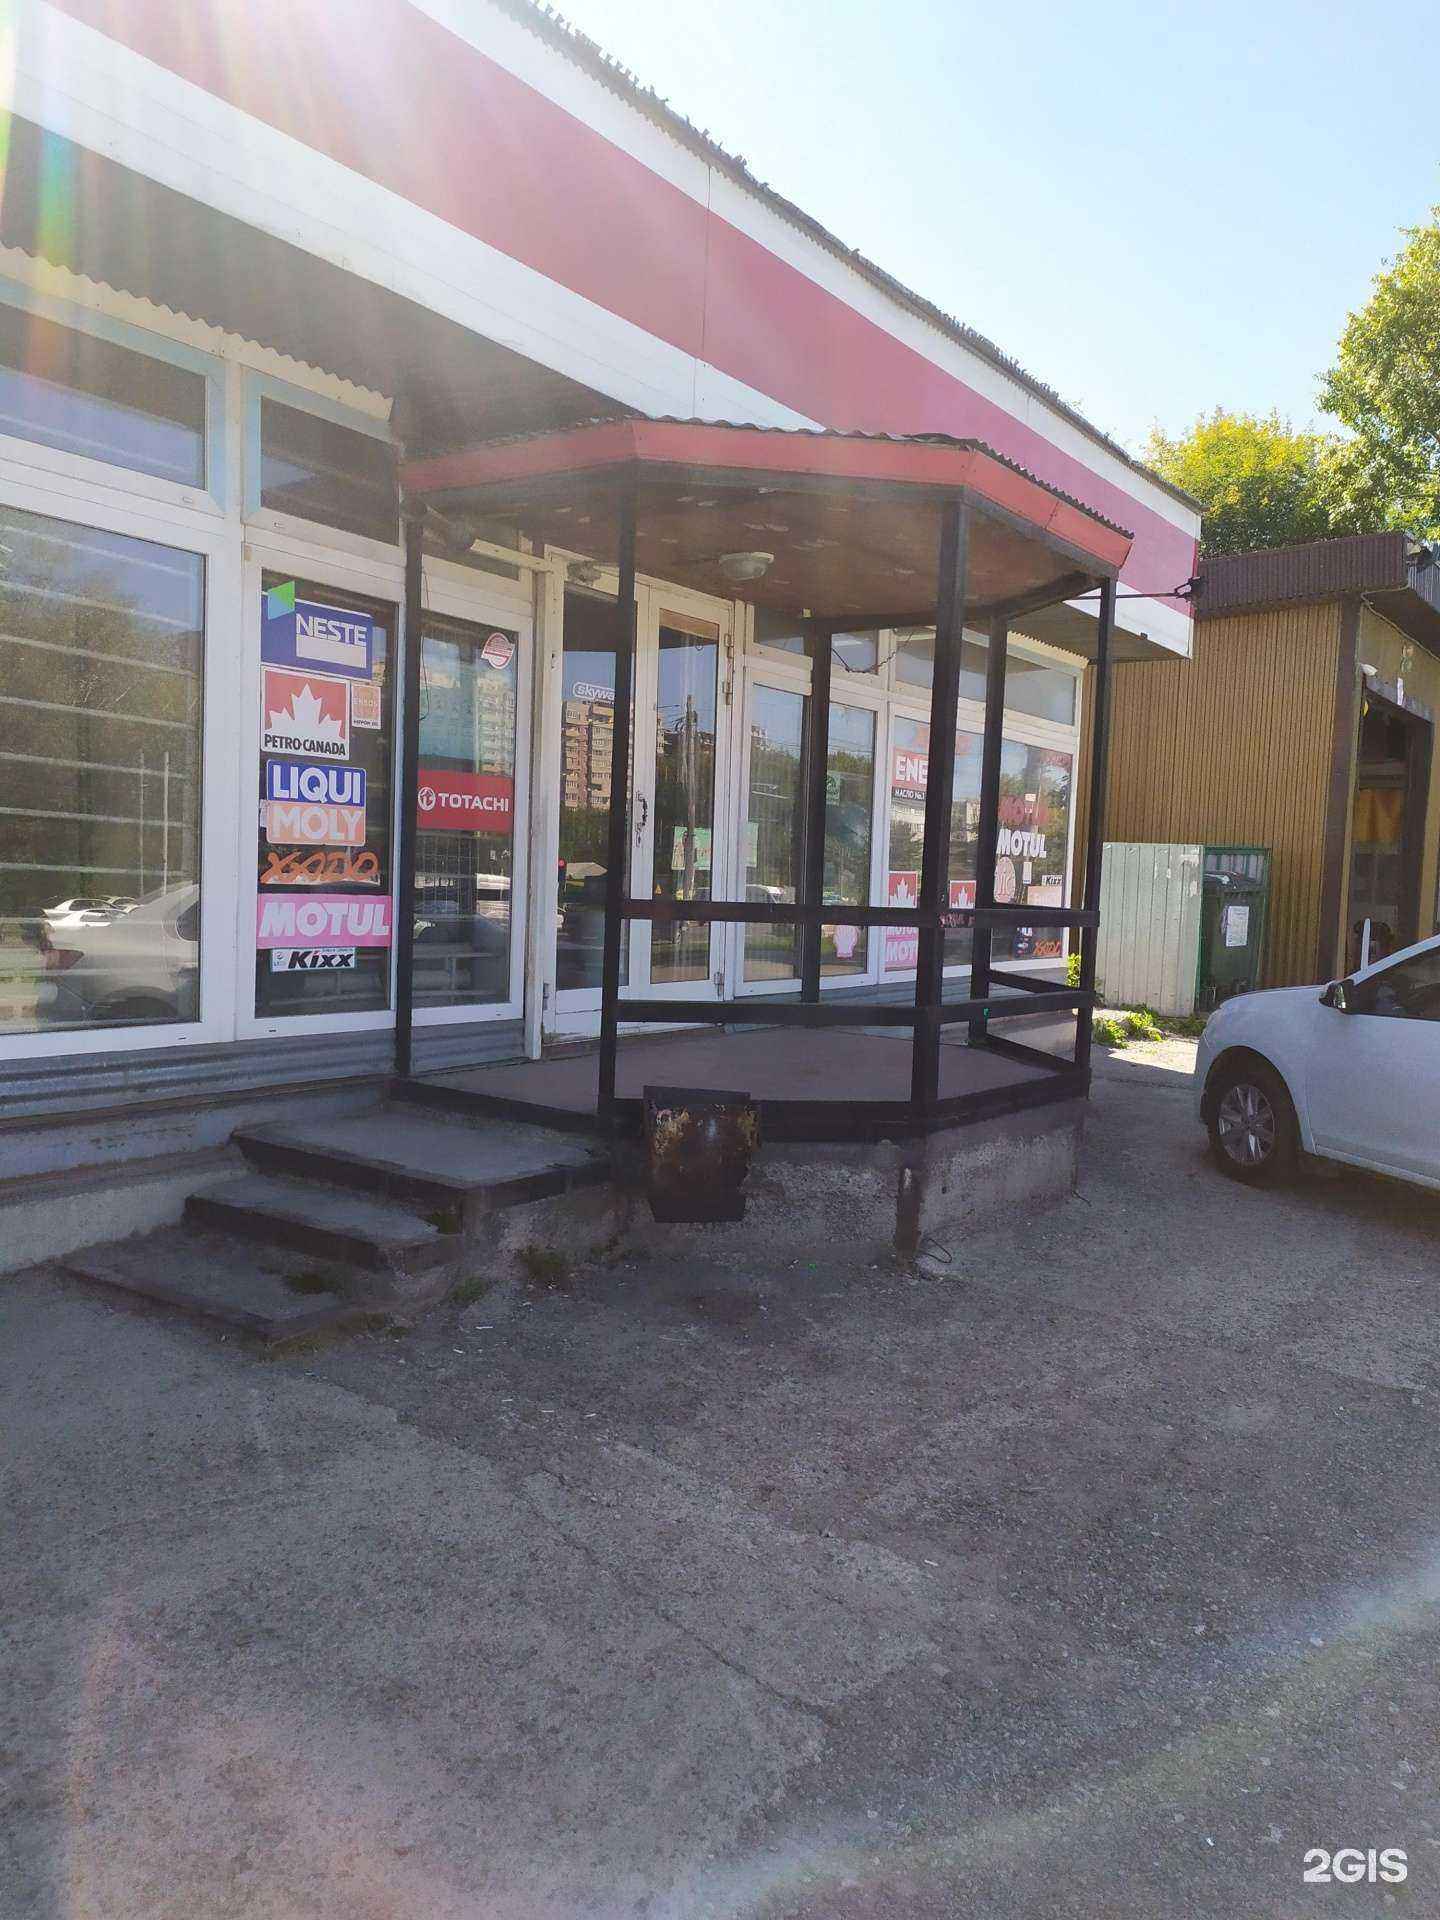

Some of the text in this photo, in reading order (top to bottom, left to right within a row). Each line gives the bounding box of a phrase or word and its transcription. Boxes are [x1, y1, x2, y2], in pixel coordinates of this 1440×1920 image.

[296, 613, 368, 647] NESTE
[577, 683, 615, 700] skywa
[273, 764, 361, 804] LIQUI
[895, 755, 929, 785] ENE
[438, 792, 509, 812] TOTACHI
[271, 806, 362, 839] MOLY
[996, 828, 1048, 858] MOTUL
[258, 901, 390, 937] MOTUL
[287, 950, 353, 969] Kixx
